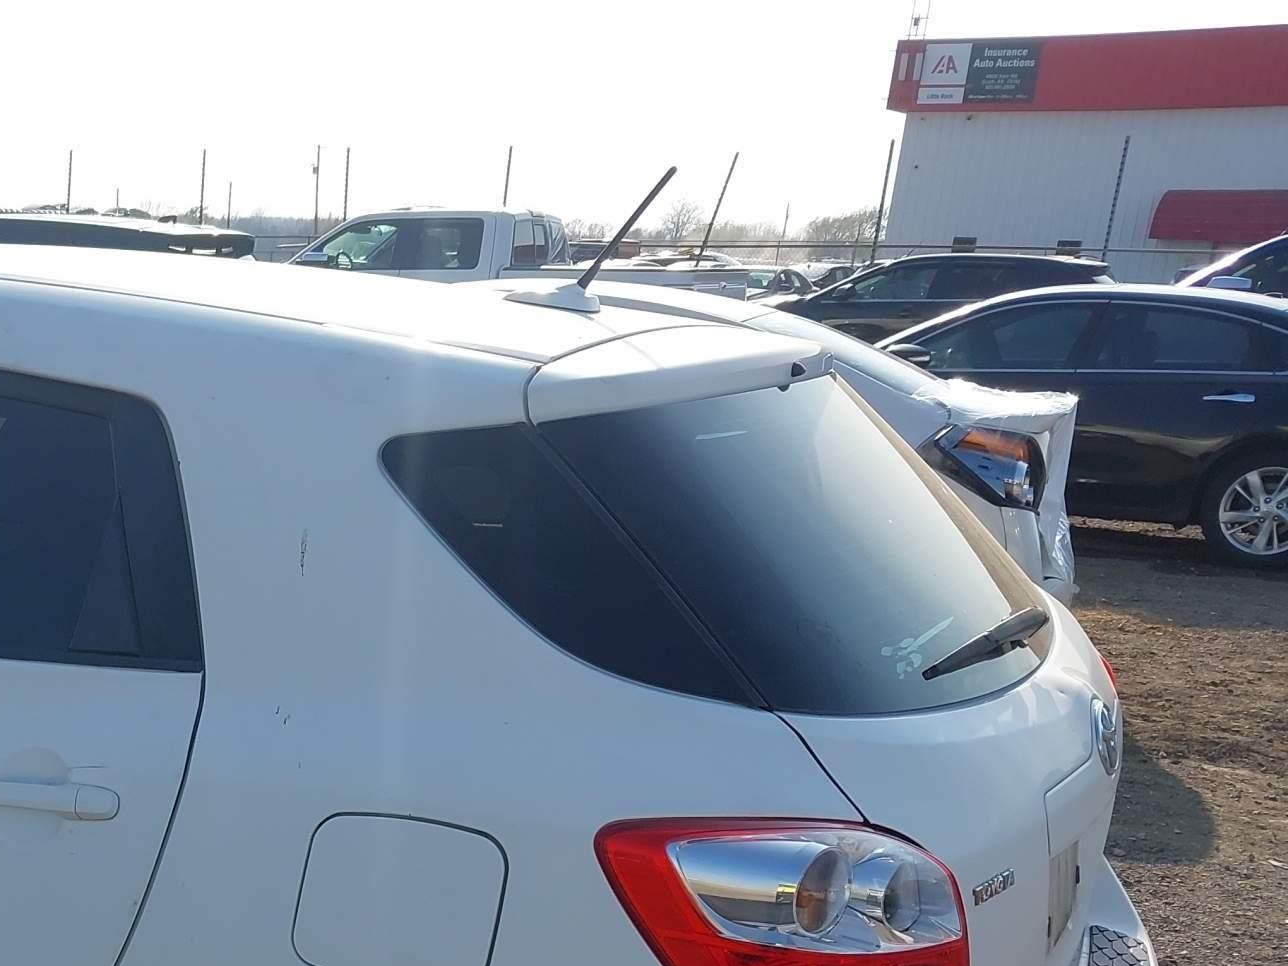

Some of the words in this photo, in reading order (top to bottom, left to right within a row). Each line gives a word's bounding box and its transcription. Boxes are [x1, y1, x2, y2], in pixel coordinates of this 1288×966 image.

[984, 47, 1029, 57] Insurance
[973, 58, 994, 68] Auto
[995, 57, 1036, 68] Auctions
[972, 867, 1016, 907] TOYOTA
